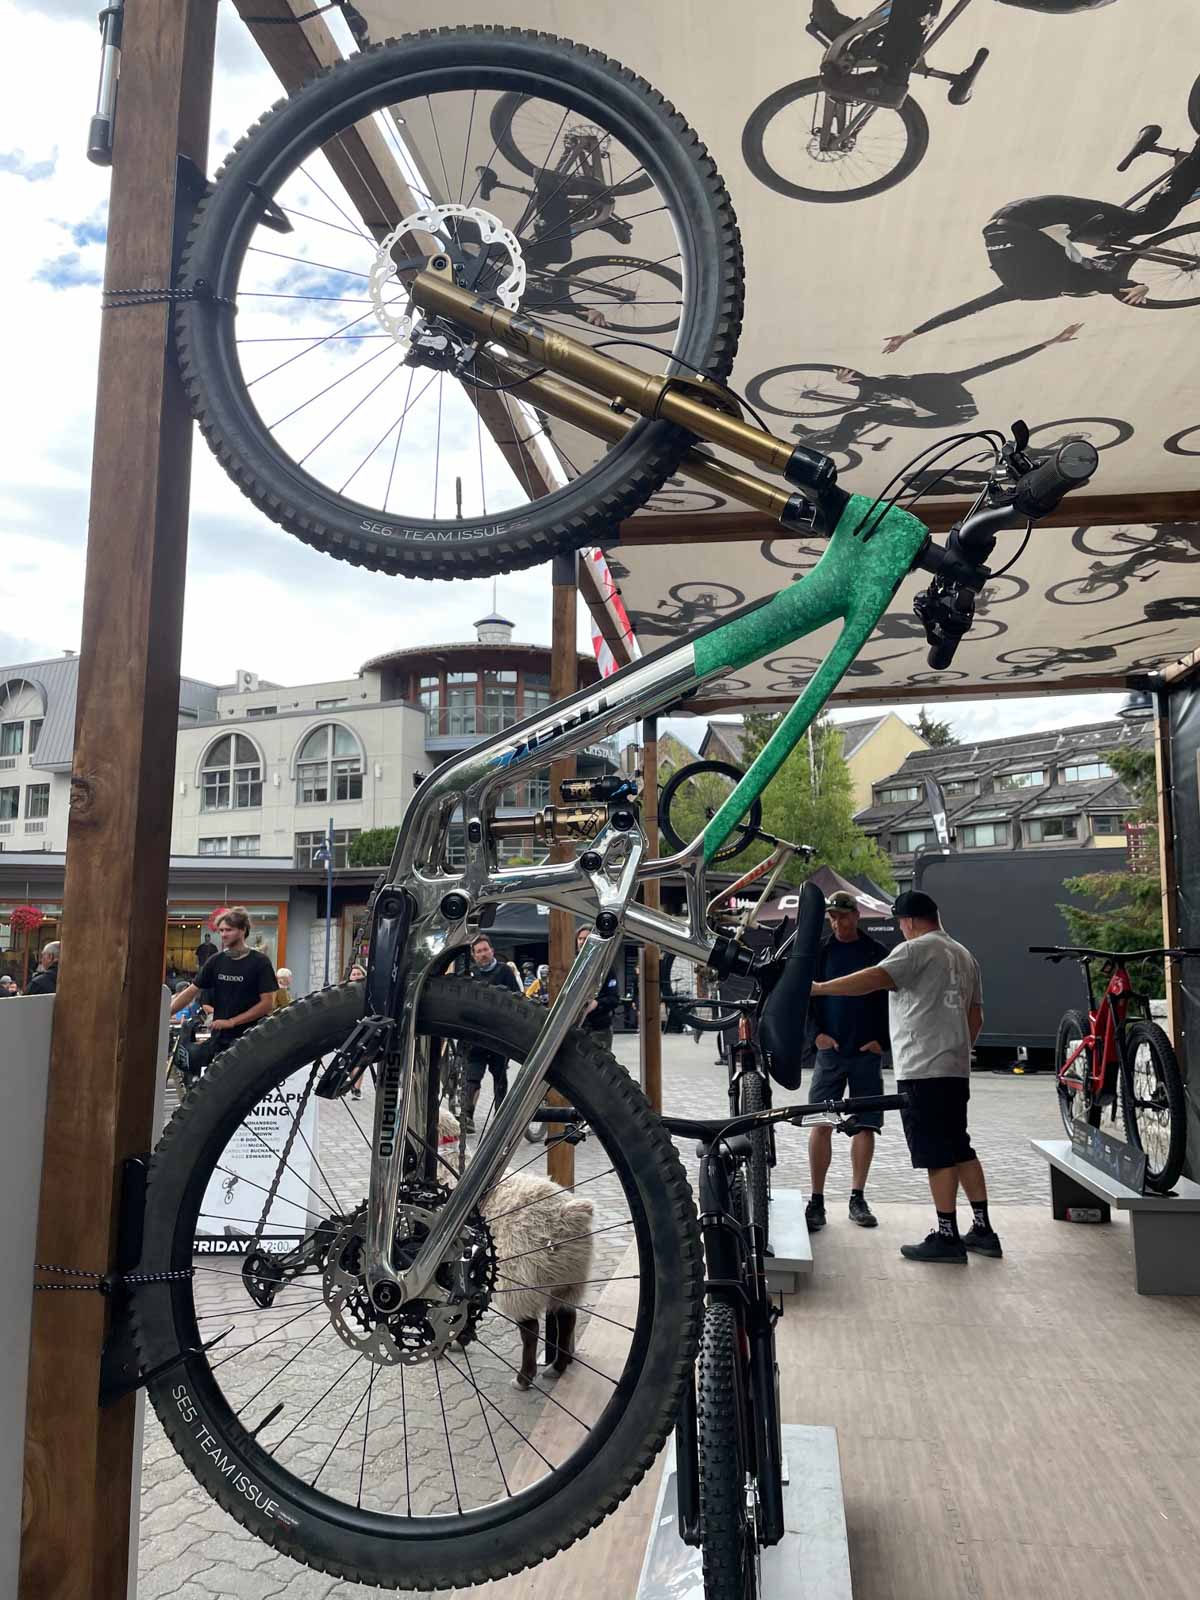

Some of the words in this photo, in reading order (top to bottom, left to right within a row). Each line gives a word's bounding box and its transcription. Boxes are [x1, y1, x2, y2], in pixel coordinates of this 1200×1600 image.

[359, 520, 393, 537] SE6
[402, 529, 453, 542] TEAM
[457, 524, 508, 541] ISSUE
[262, 1093, 305, 1103] RAPH
[248, 1106, 290, 1117] NING
[193, 1240, 251, 1253] FRIDAY
[172, 1384, 198, 1423] SE5
[195, 1424, 236, 1477] TEAM
[232, 1472, 279, 1518] ISSUE
